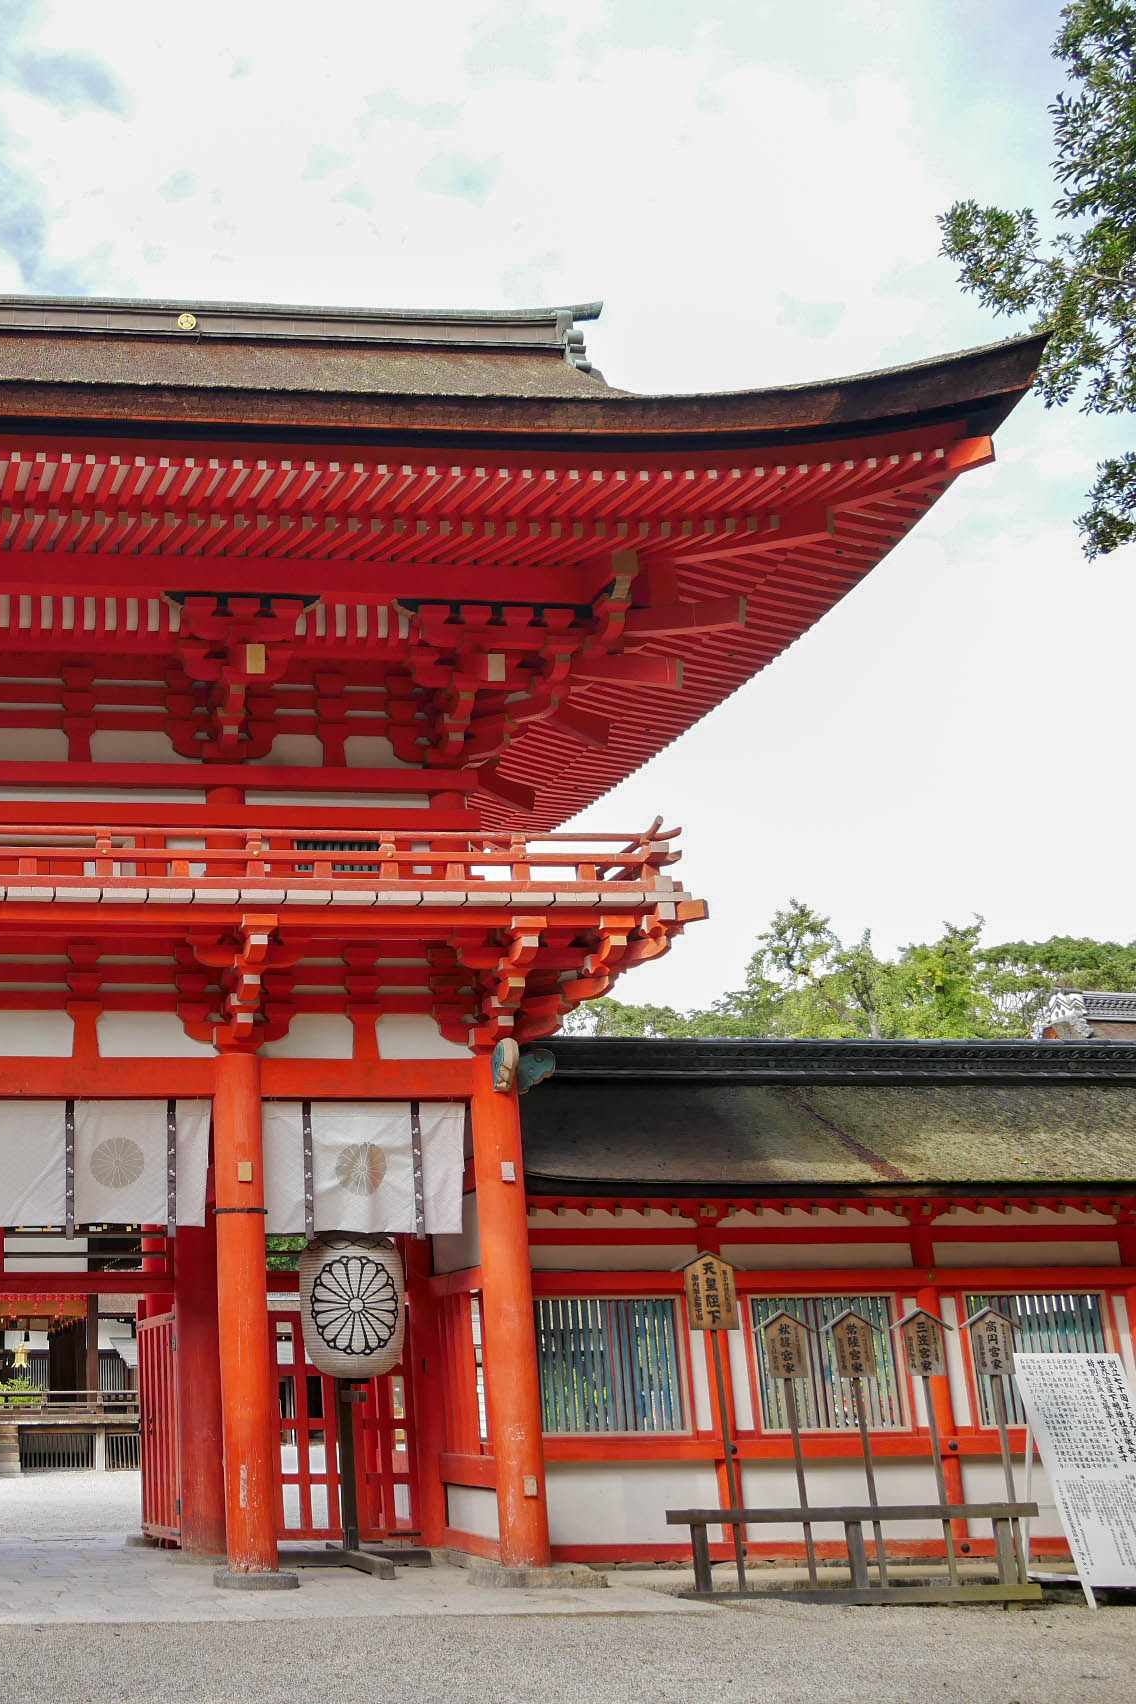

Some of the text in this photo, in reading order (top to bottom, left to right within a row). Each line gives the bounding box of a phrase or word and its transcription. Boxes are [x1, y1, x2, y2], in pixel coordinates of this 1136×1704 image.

[702, 1262, 721, 1325] 天皇陛下
[916, 1321, 933, 1372] 三笠宮家
[985, 1319, 1004, 1370] 高円宮家
